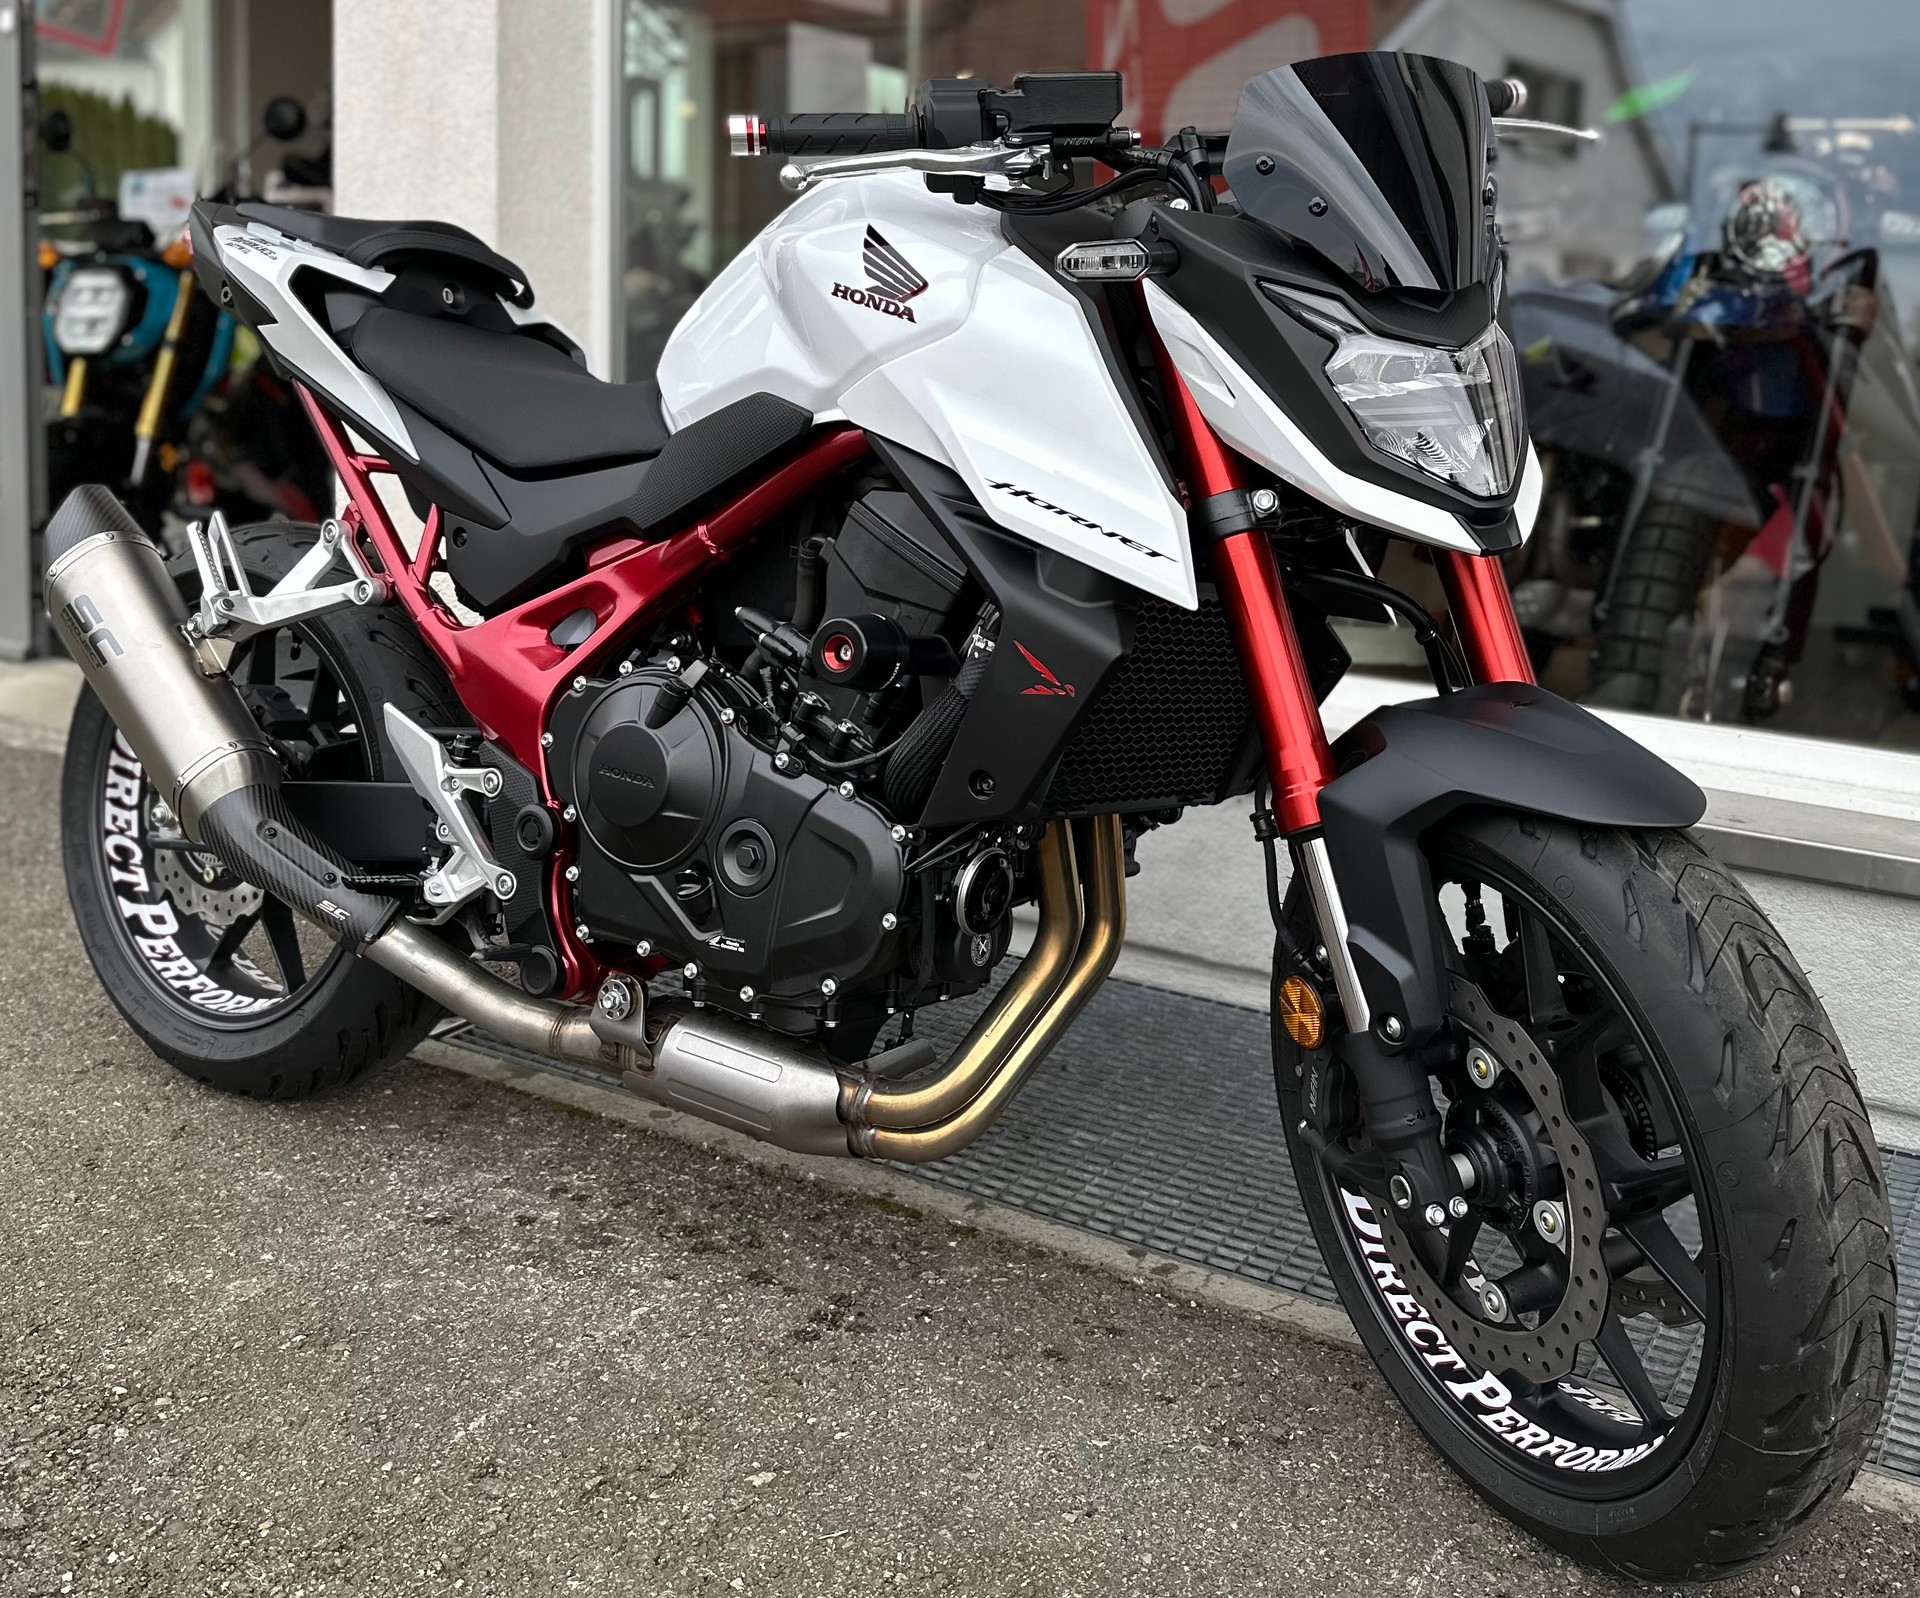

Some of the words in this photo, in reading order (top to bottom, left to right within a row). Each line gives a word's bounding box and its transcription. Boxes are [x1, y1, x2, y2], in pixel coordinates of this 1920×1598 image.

[831, 282, 917, 324] HONDA
[984, 477, 1179, 563] HORNET
[60, 606, 104, 669] PROJECT
[66, 594, 124, 666] SC
[598, 764, 656, 789] HONDA
[320, 899, 351, 920] SC
[1340, 1186, 1467, 1373] DIRECT
